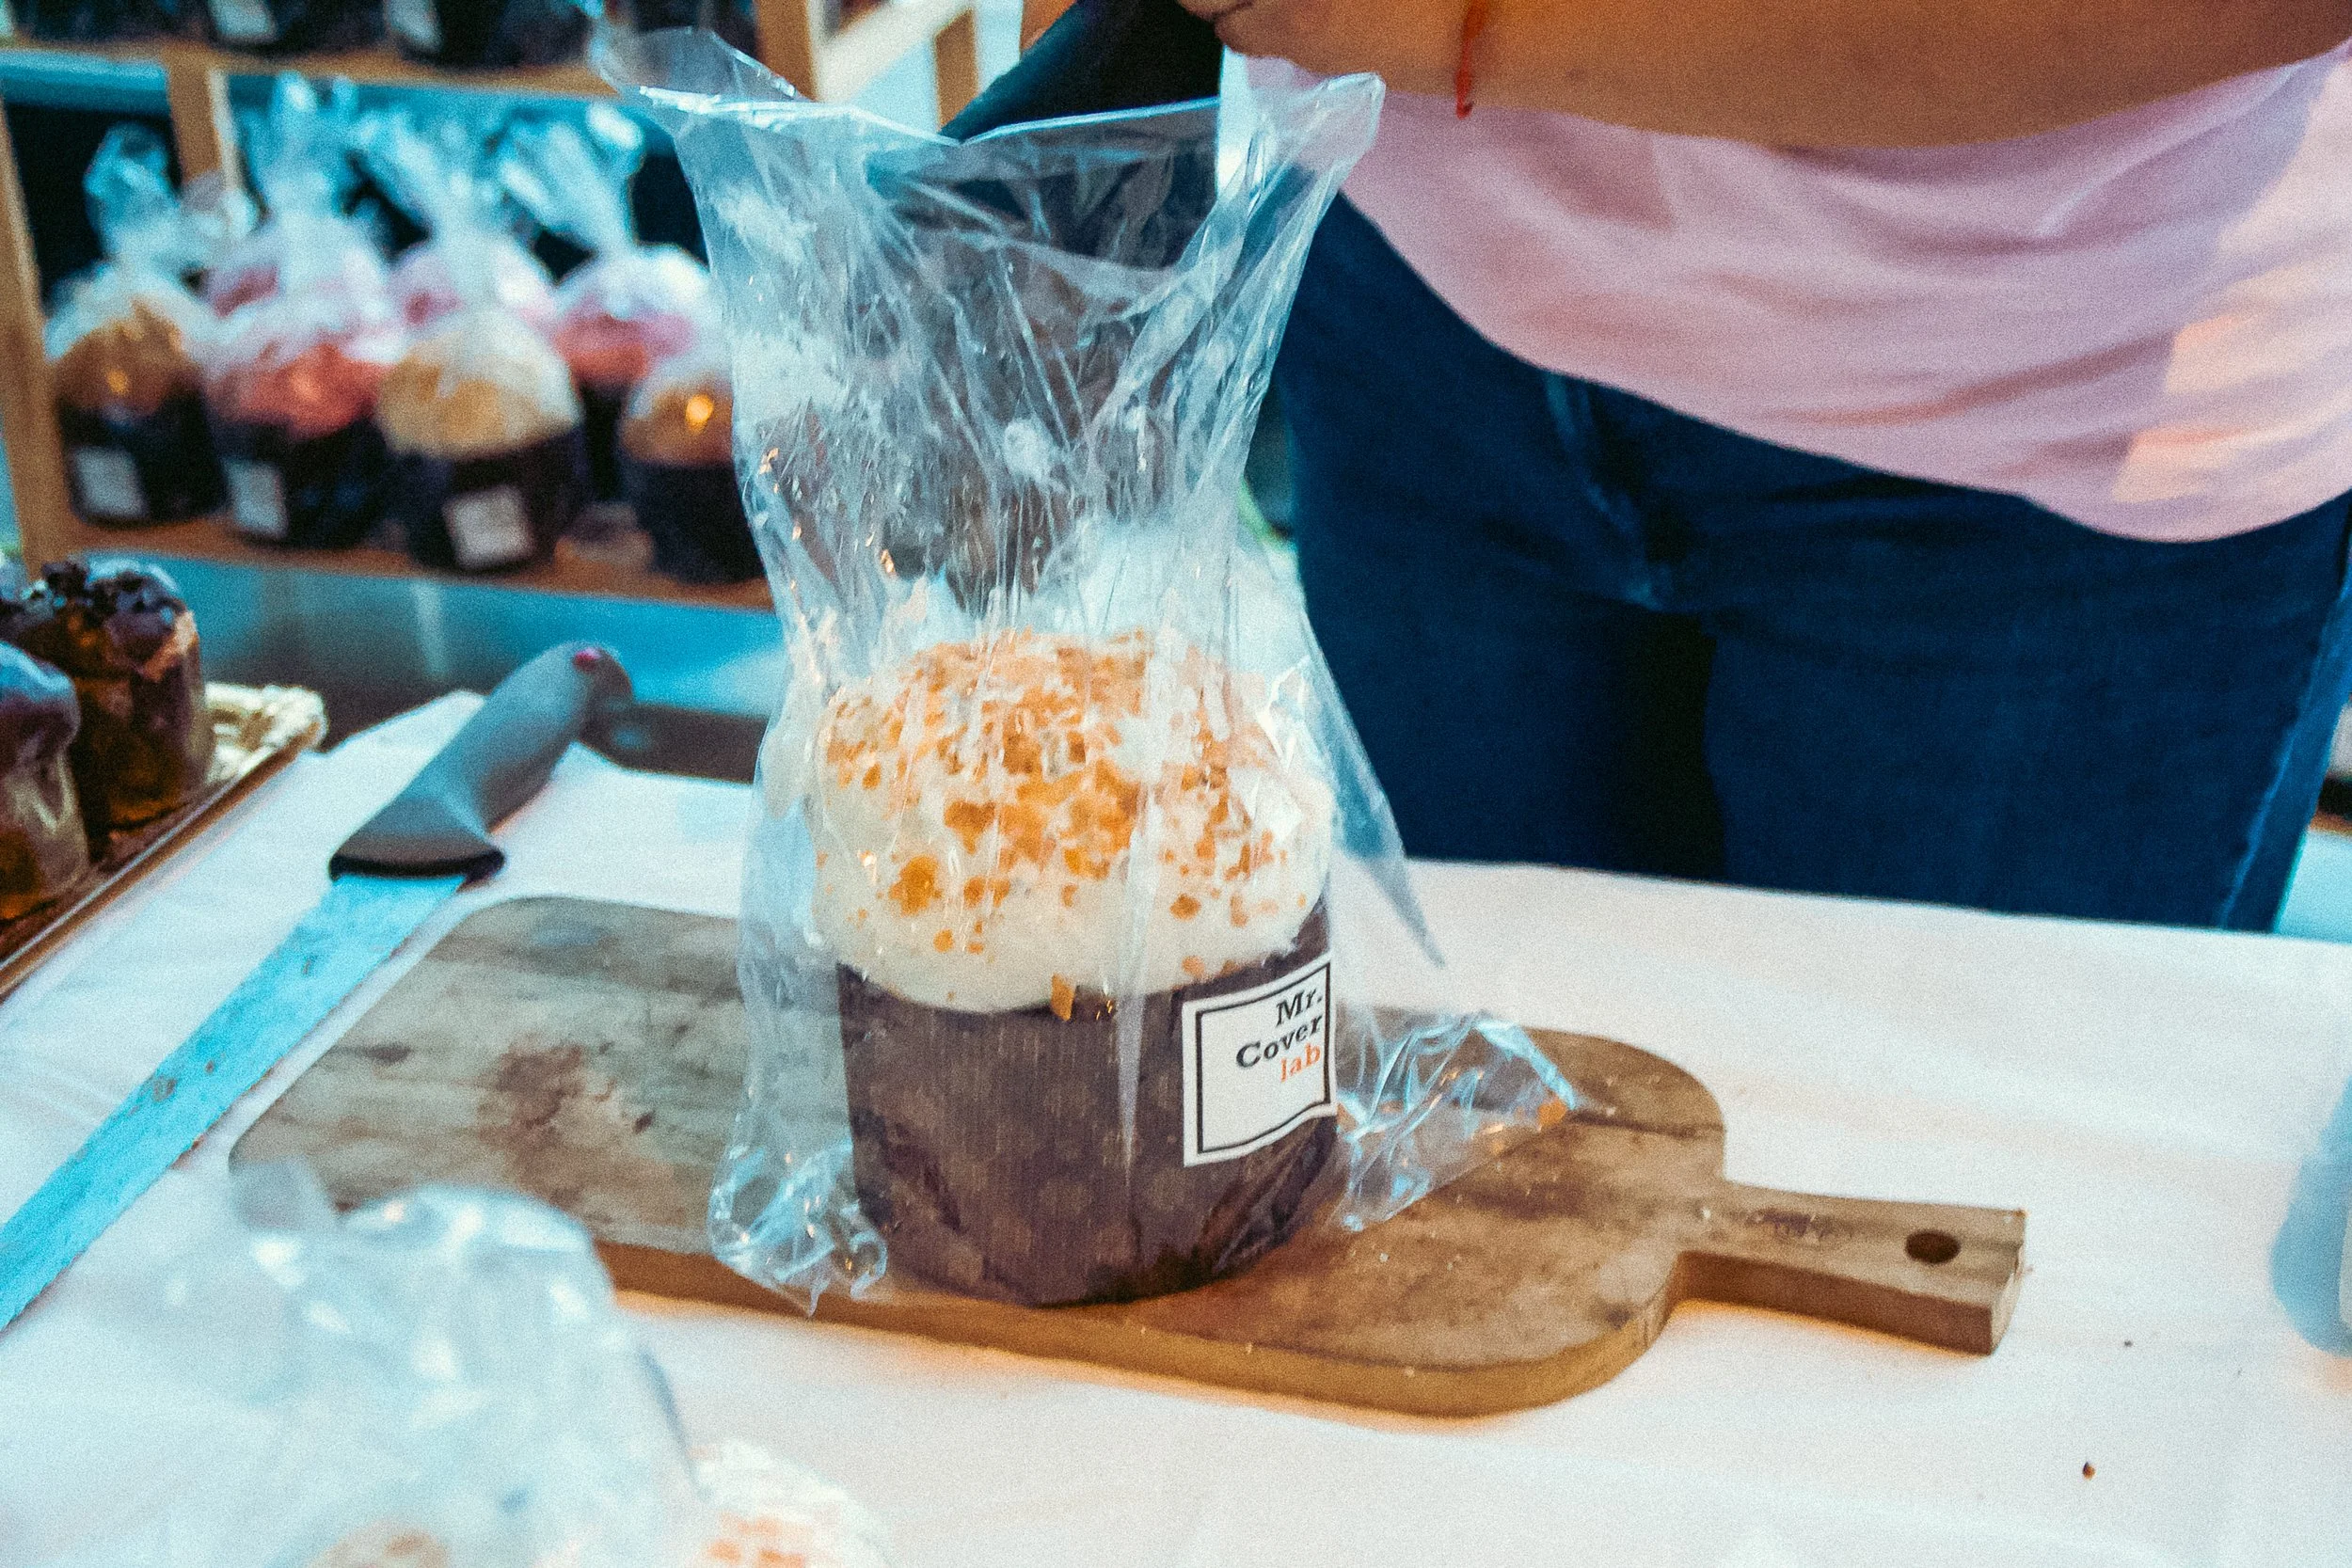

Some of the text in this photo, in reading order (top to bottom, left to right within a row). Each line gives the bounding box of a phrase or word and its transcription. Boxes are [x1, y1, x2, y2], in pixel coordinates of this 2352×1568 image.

[1276, 988, 1323, 1027] Mr.
[1236, 1014, 1323, 1068] Cover
[1279, 1042, 1321, 1083] lab
